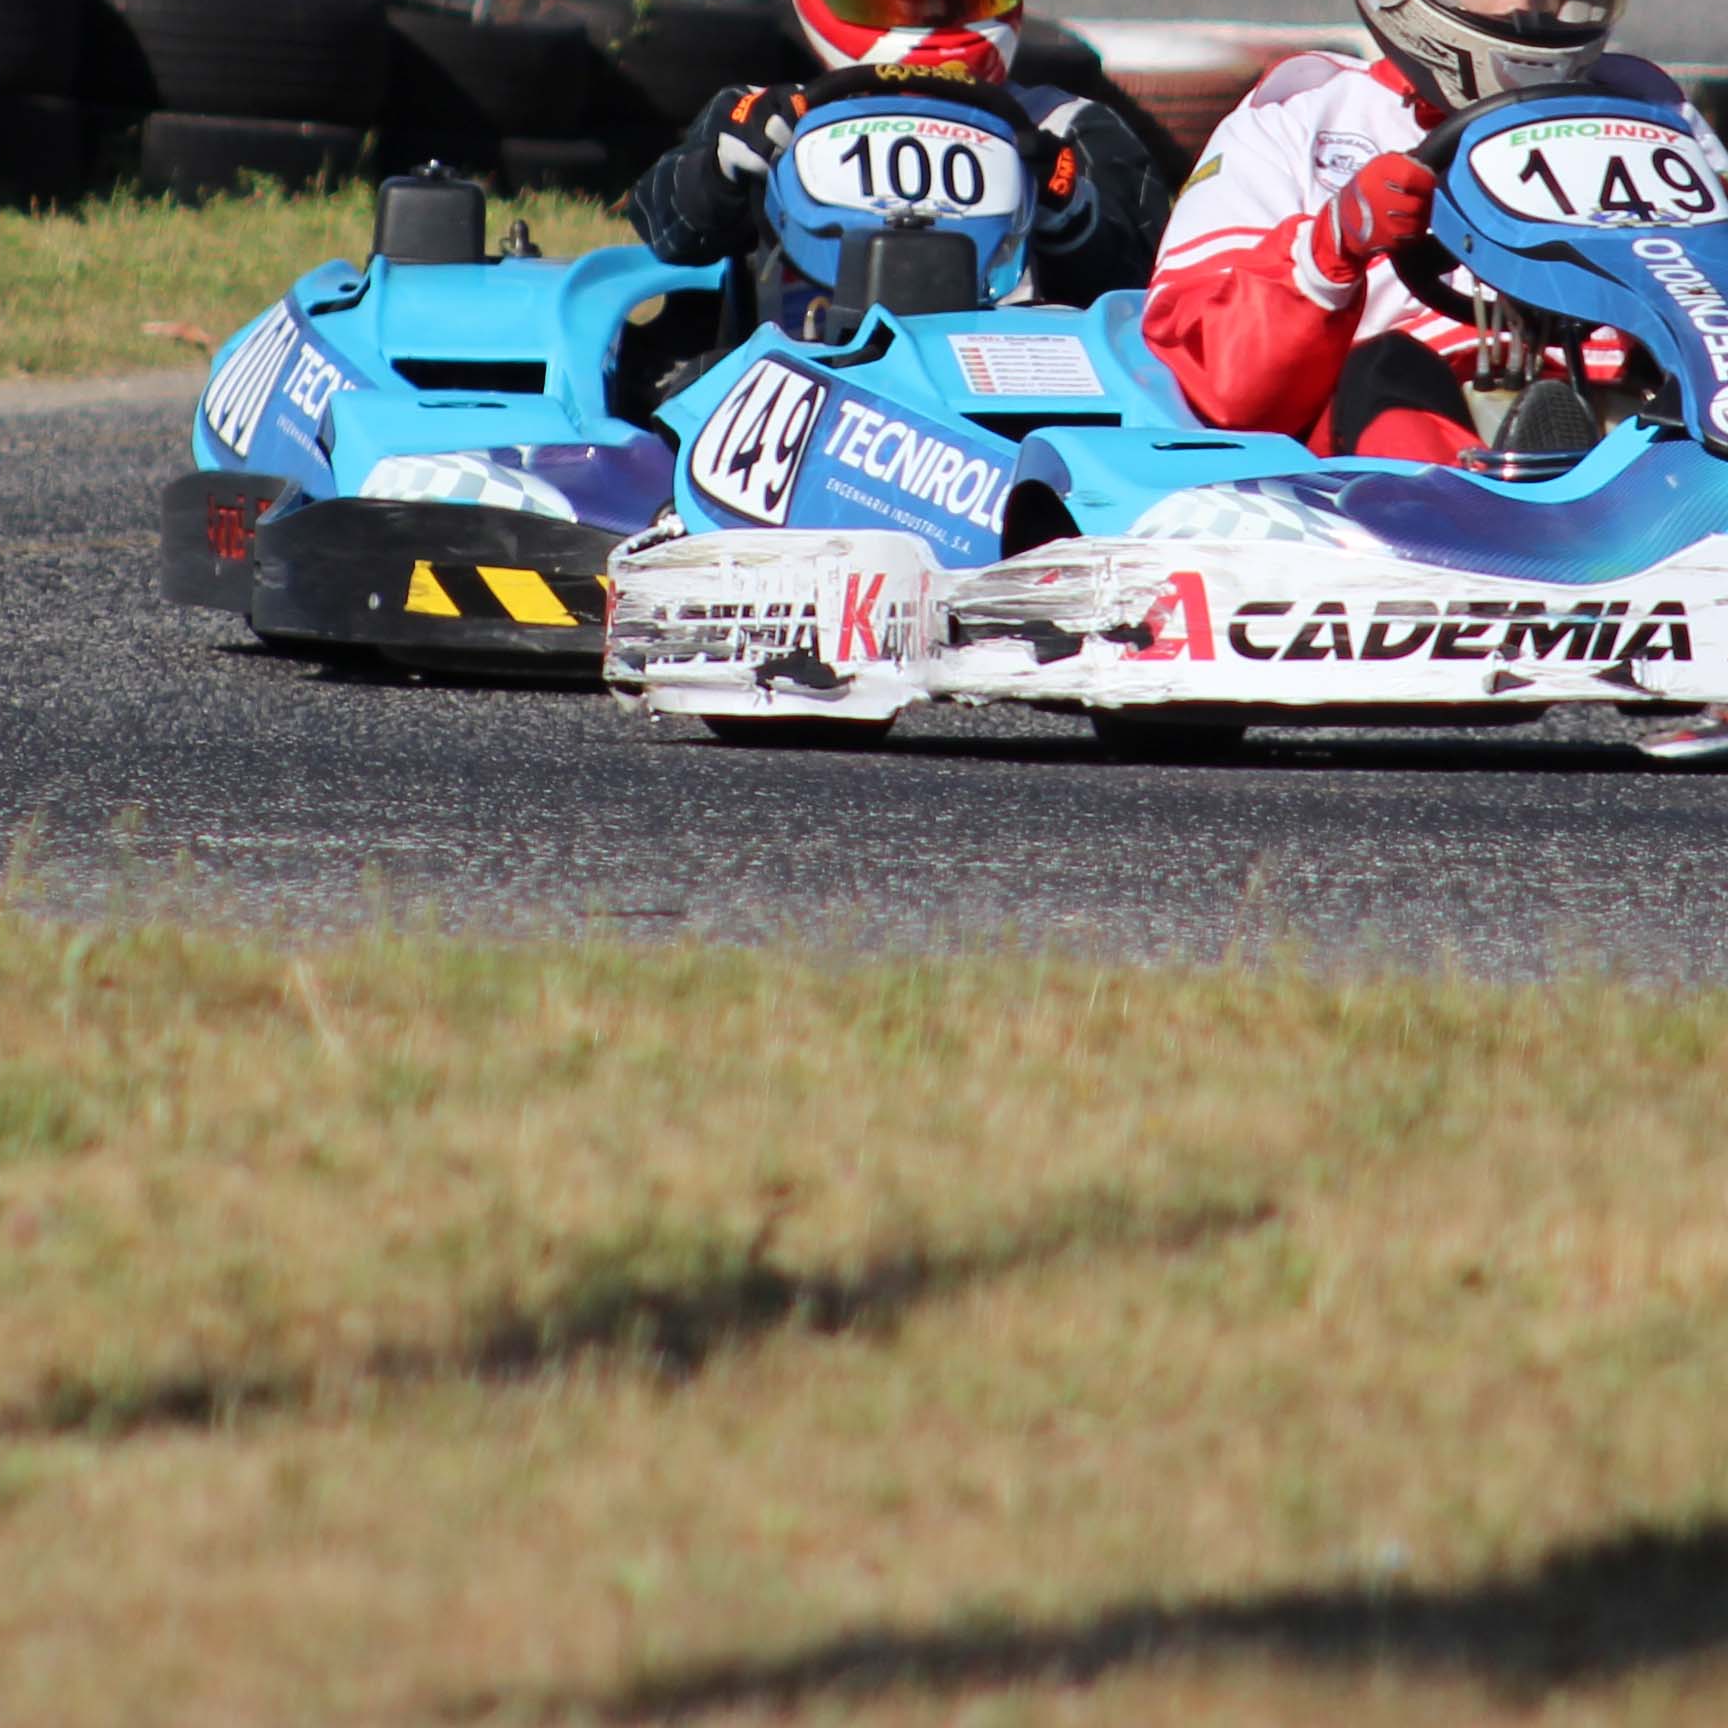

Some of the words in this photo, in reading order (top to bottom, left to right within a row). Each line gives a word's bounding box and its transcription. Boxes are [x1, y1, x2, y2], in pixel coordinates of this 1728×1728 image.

[827, 120, 995, 145] EUROINDY
[1509, 122, 1682, 147] EUROINDY
[839, 135, 986, 206] 100
[1518, 147, 1716, 223] 149
[710, 358, 821, 512] 149
[824, 477, 891, 517] ENGENHARIA
[1118, 571, 1693, 662] ACADEMIA
